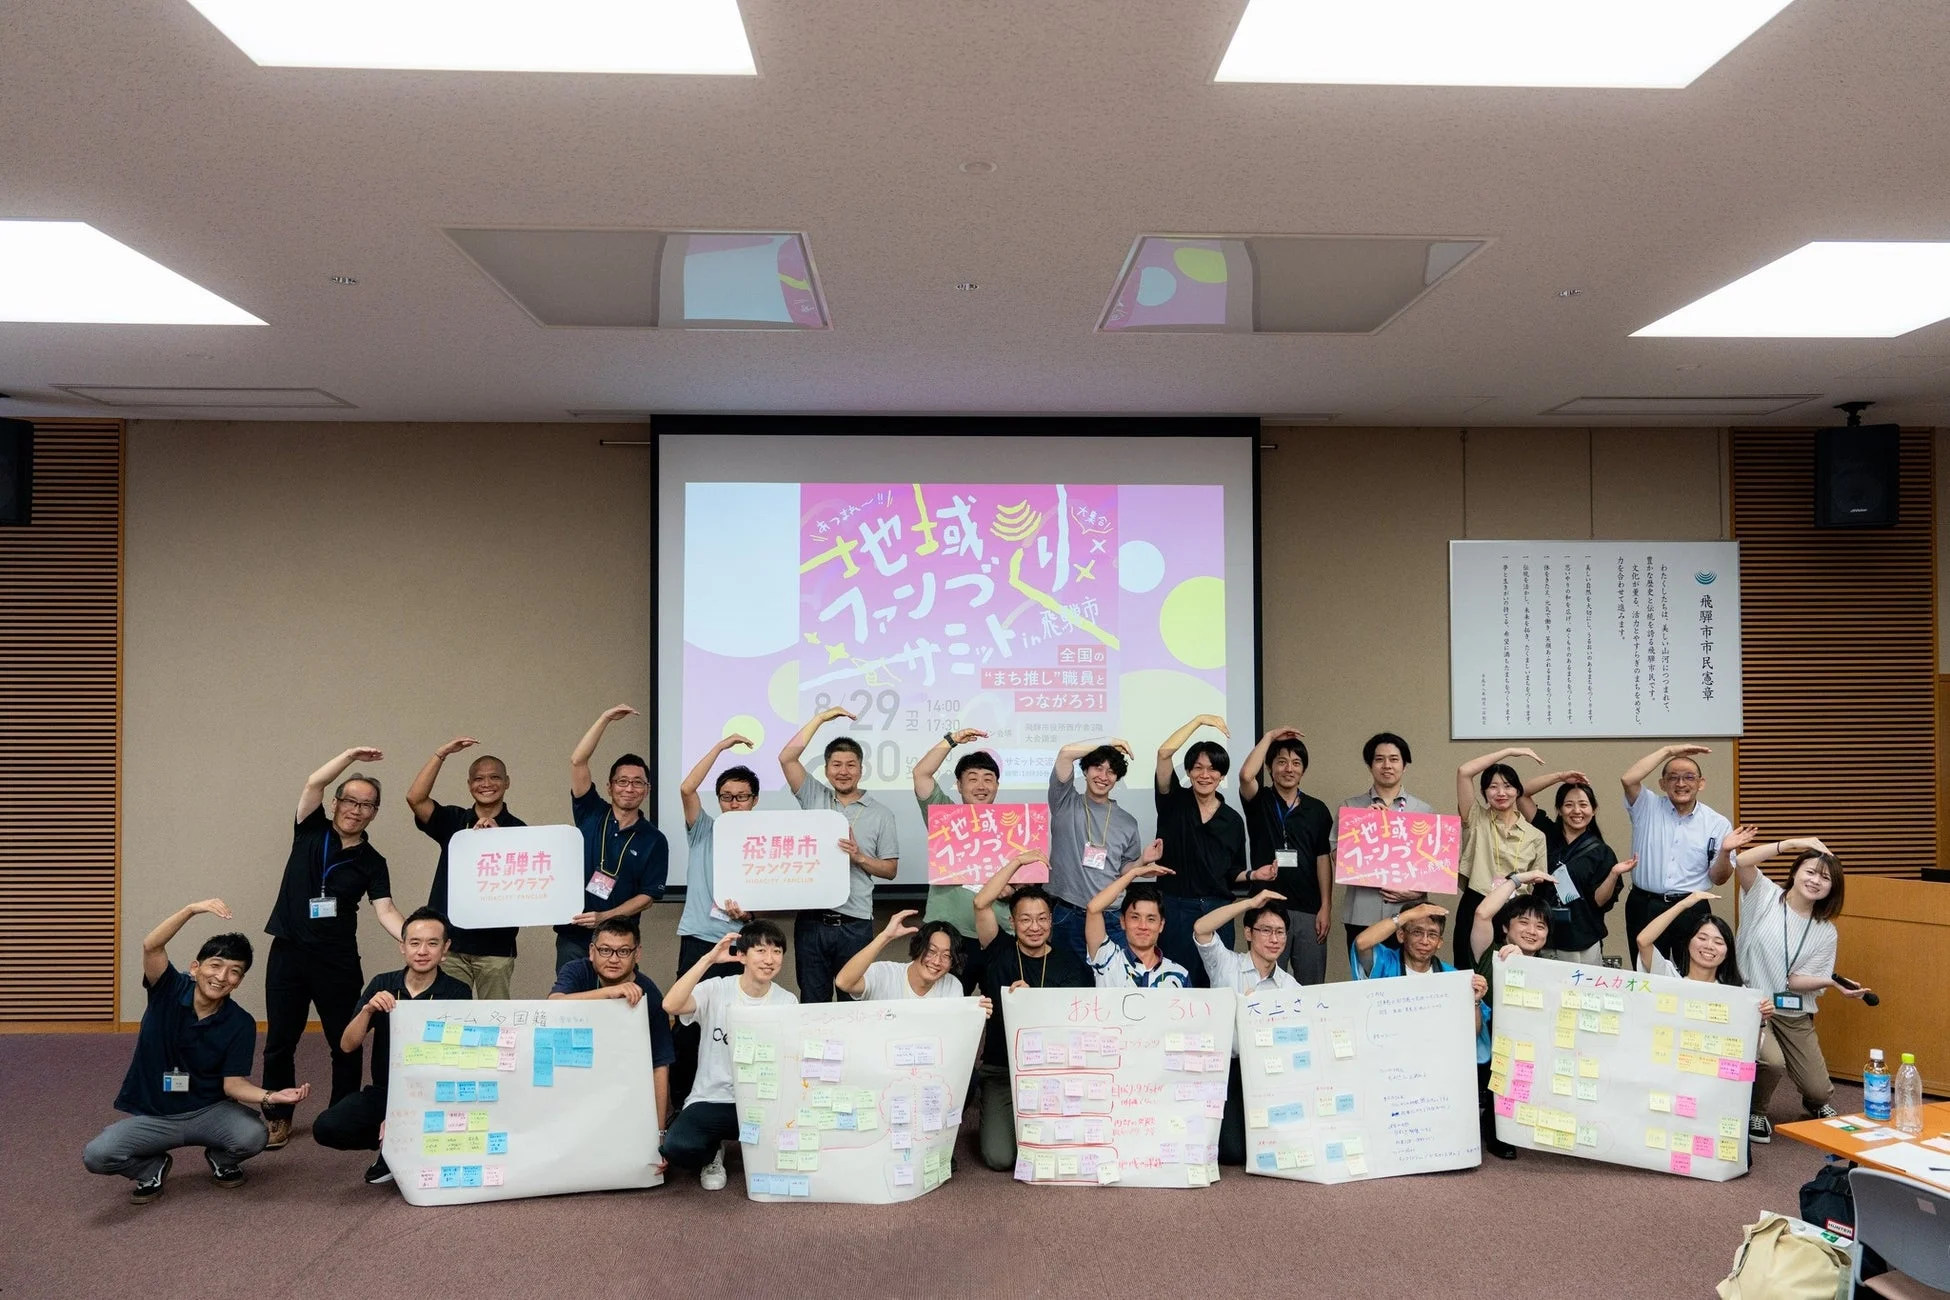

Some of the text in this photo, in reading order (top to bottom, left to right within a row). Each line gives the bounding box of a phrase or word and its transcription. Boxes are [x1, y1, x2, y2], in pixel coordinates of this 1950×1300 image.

[800, 484, 985, 580] 地域
[1060, 647, 1105, 663] 全国の
[927, 699, 961, 712] 14:00
[906, 710, 919, 731] FRI
[927, 719, 961, 732] 17:30
[742, 834, 818, 859] 飛騨市
[476, 850, 552, 877] 飛騨市
[741, 859, 821, 875] ファンクラブ
[476, 874, 555, 893] ファンクラブ
[1828, 1222, 1852, 1235] HUNTER
